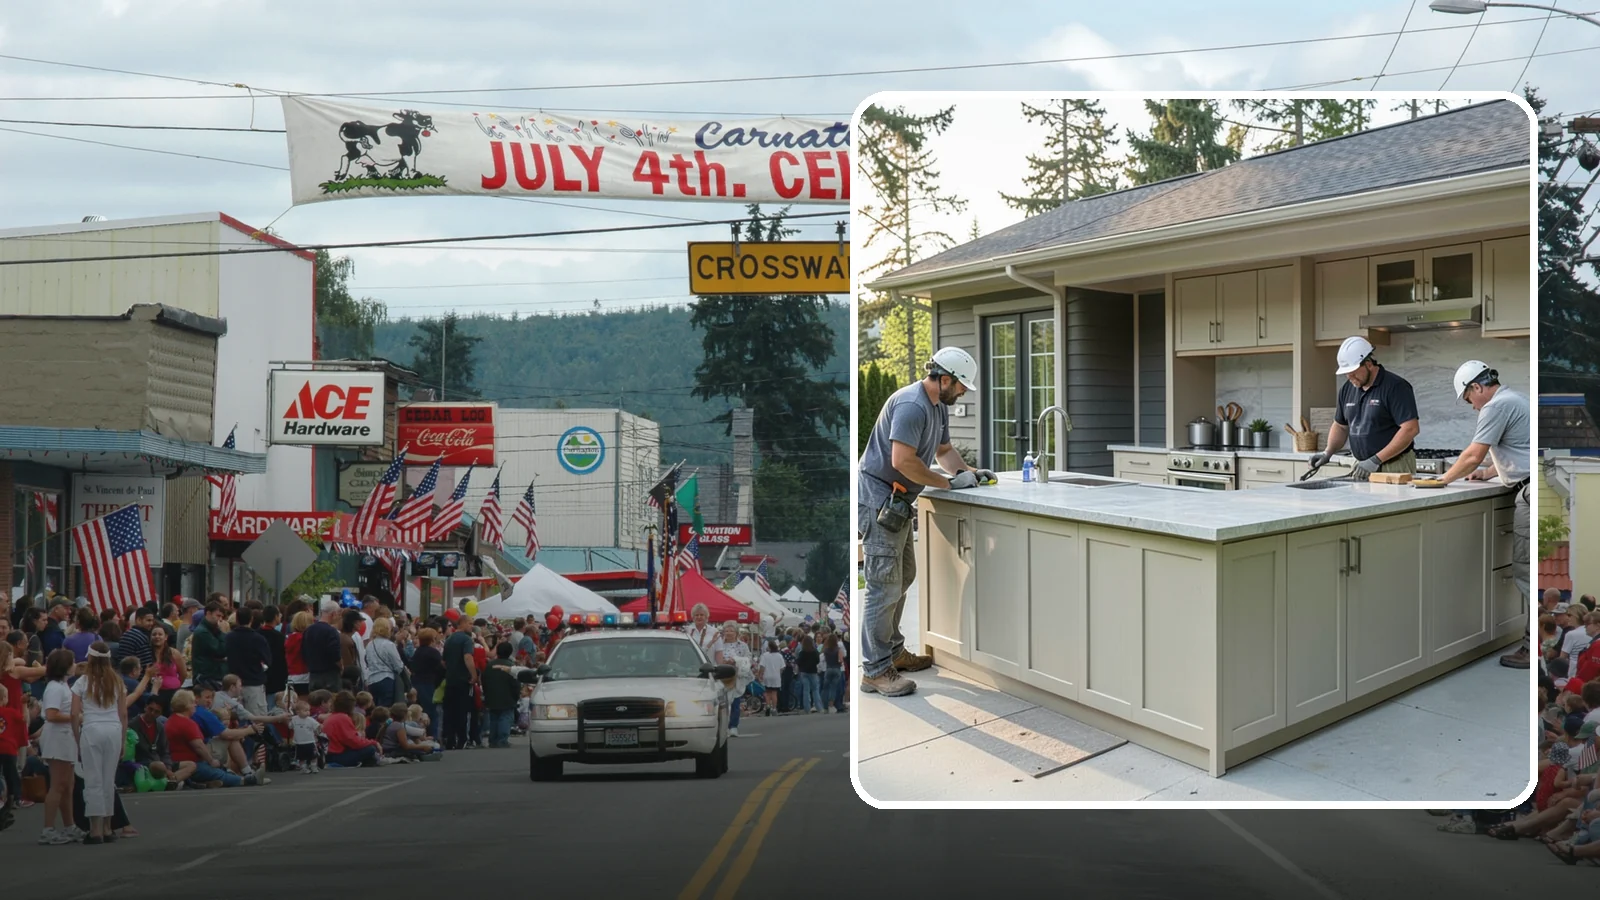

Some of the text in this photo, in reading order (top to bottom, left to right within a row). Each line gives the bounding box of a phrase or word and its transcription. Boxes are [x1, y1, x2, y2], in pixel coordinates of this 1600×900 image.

[694, 121, 850, 150] Carnat
[480, 141, 604, 193] JULY
[632, 150, 747, 198] 4th.
[696, 253, 850, 280] CROSSWA
[282, 379, 374, 420] ACE
[405, 409, 453, 421] CEDAR
[282, 421, 371, 437] Hardware
[416, 428, 477, 447] Coca-Cola
[353, 467, 386, 479] Simpl
[83, 485, 155, 496] St. Vincent de Paul
[80, 503, 154, 522] THT
[212, 516, 331, 535] HARDARE
[687, 526, 741, 535] CRNATION
[699, 535, 730, 544] GLASS
